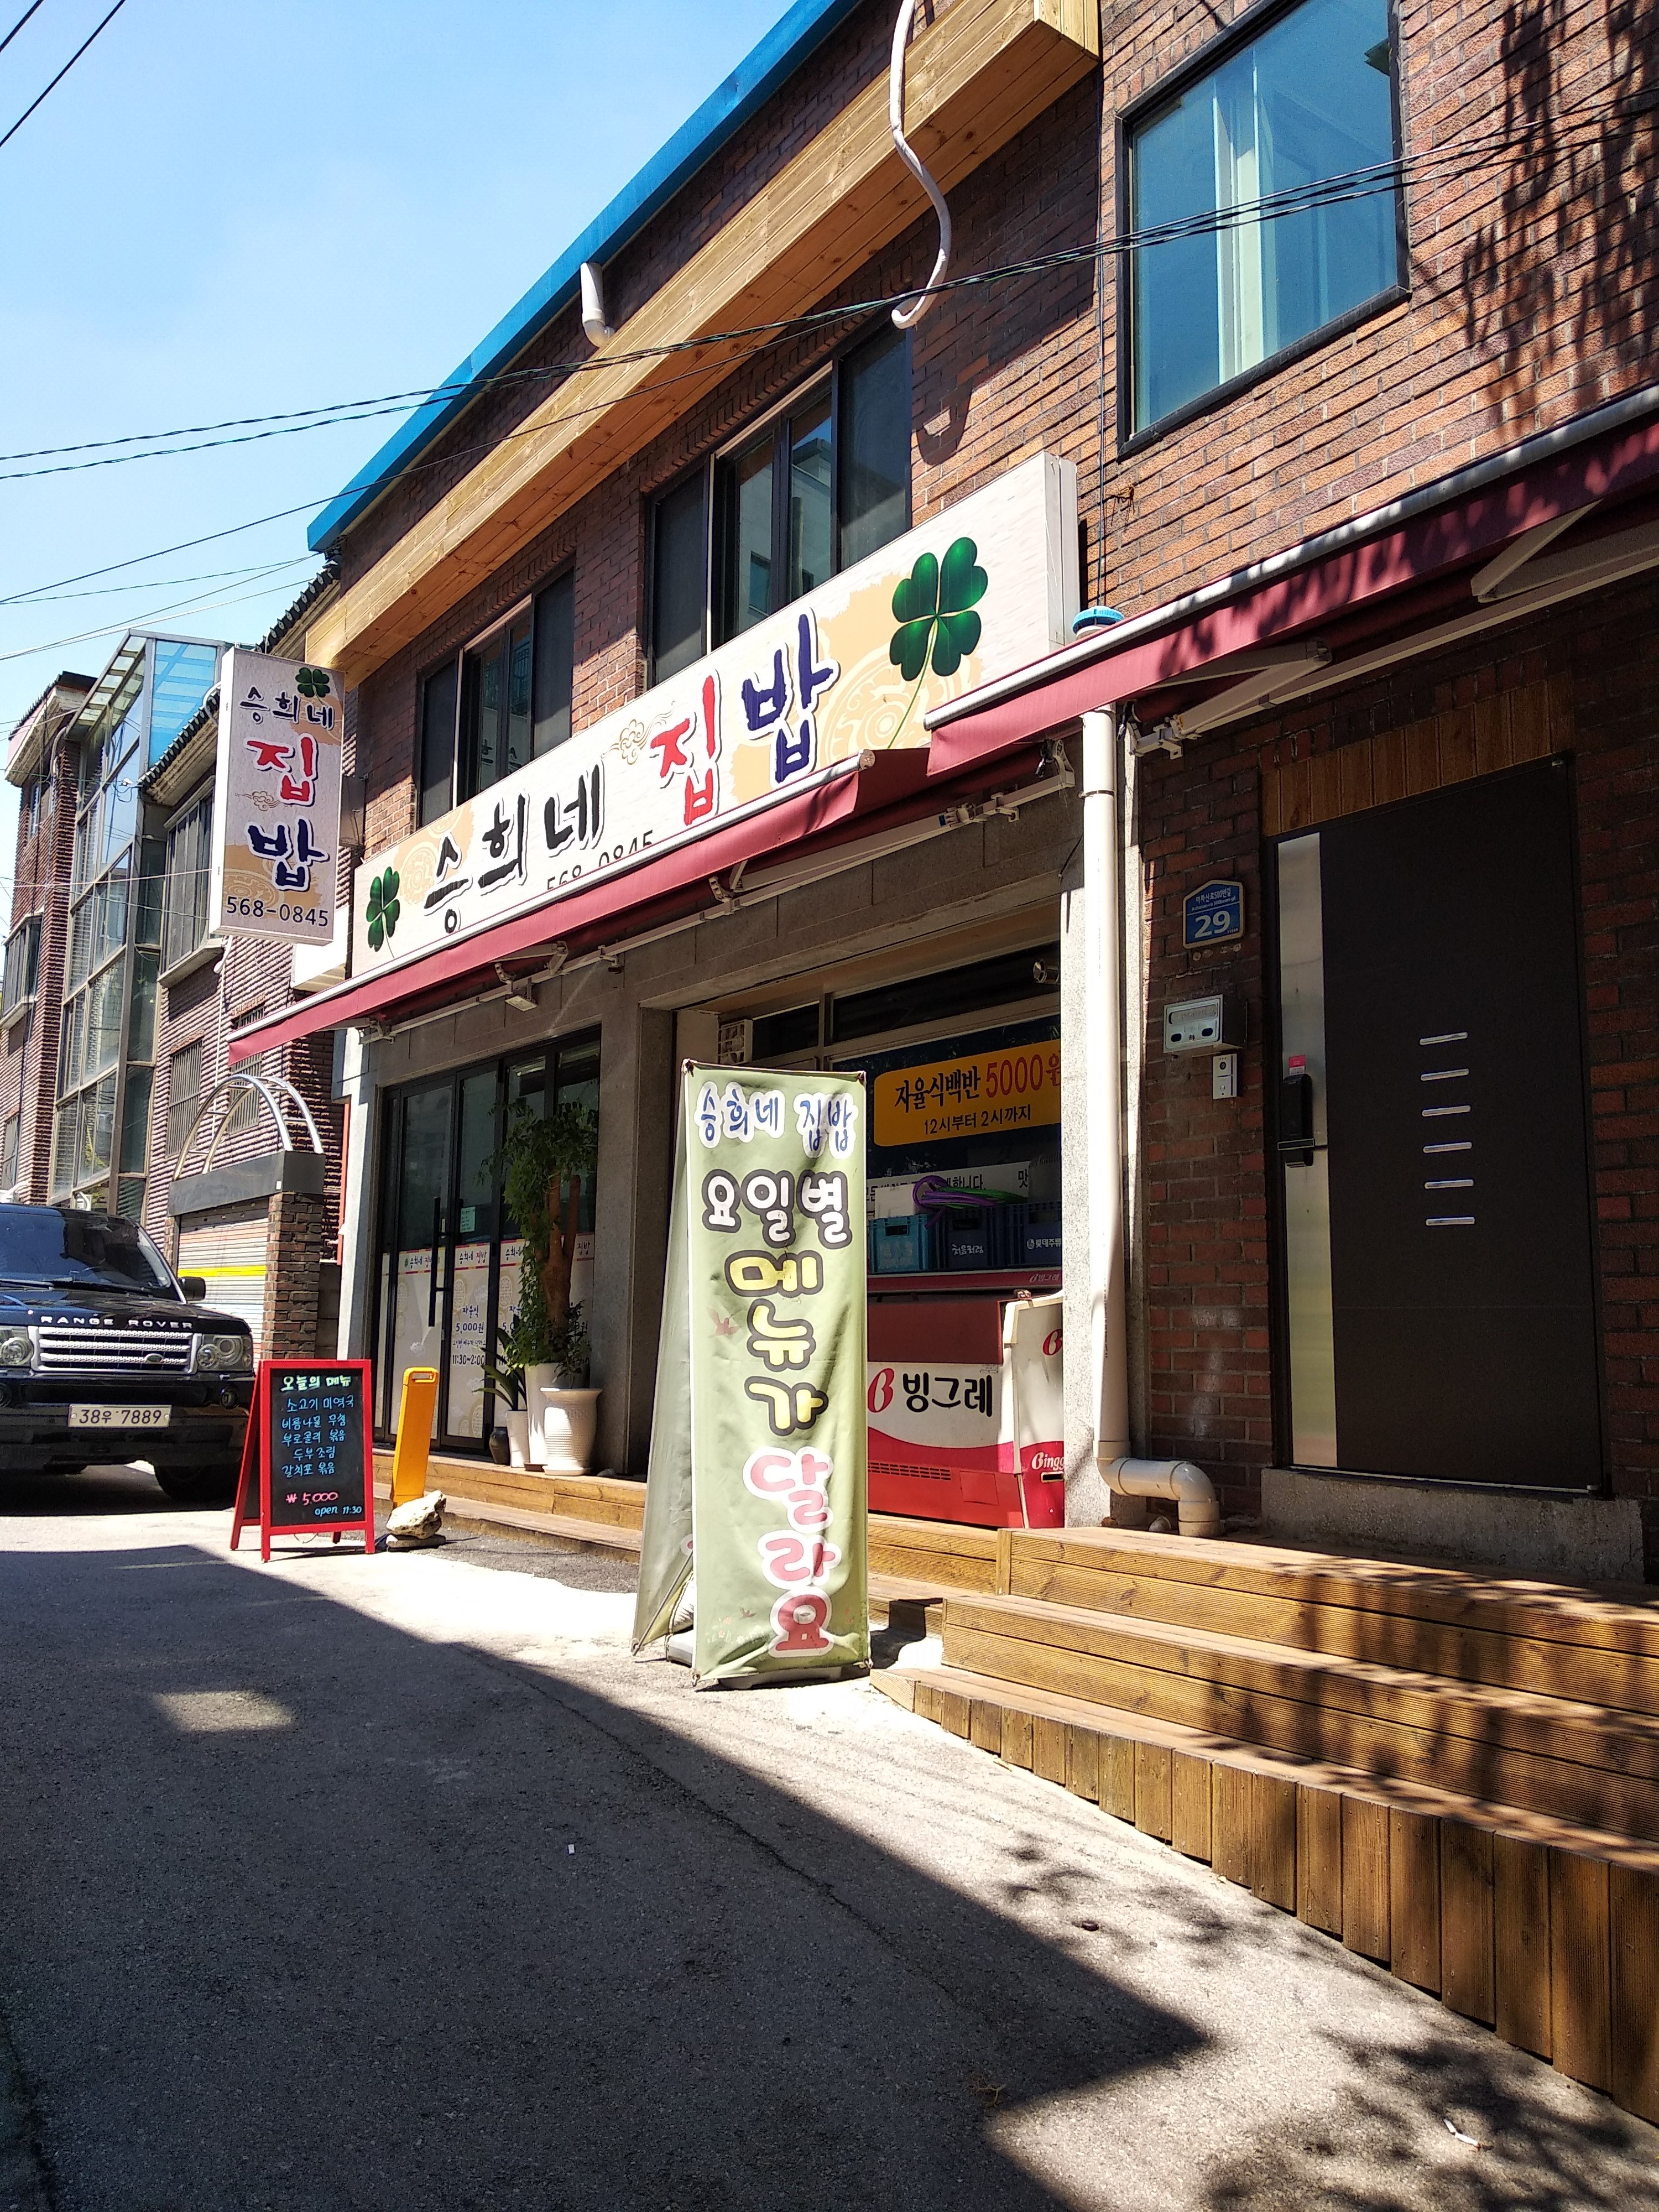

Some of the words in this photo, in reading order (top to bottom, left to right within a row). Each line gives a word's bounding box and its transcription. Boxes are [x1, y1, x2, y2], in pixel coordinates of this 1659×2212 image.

[240, 686, 333, 729] 승희네
[424, 763, 601, 934] 승희네
[650, 613, 834, 826] 집밥
[226, 896, 329, 927] 568-0845
[1194, 910, 1231, 938] 29
[894, 1065, 981, 1113] 자율식백반
[700, 1088, 779, 1142] 승희네
[800, 1098, 853, 1152] 집밥
[924, 1111, 977, 1135] 12시부터
[980, 1104, 1031, 1127] 2시까지
[705, 1172, 850, 1246] 요일별
[577, 1241, 591, 1256] 집밥
[951, 1243, 984, 1256] 처음처럼
[459, 1250, 474, 1265] 승희네
[476, 1250, 487, 1264] 집밥
[462, 1305, 479, 1319] 자율식
[40, 1316, 114, 1325] RANGE
[128, 1319, 192, 1329] ROVER
[455, 1321, 484, 1334] 5,000원
[452, 1354, 485, 1365] 11:30~2:00
[280, 1375, 320, 1391] 오늘의
[325, 1375, 352, 1387] 메뉴
[902, 1371, 993, 1418] 빙그레
[286, 1397, 319, 1413] 소고기
[322, 1394, 354, 1410] 미역국
[79, 1409, 112, 1425] 38우
[121, 1409, 162, 1425] 7889
[281, 1415, 321, 1431] 비름나물
[281, 1431, 321, 1447] 부로콜리
[328, 1428, 346, 1443] 볶음
[317, 1461, 335, 1475] 볶음
[1031, 1452, 1065, 1471] Bingg
[314, 1505, 338, 1517] open
[342, 1505, 362, 1515] 11:30
